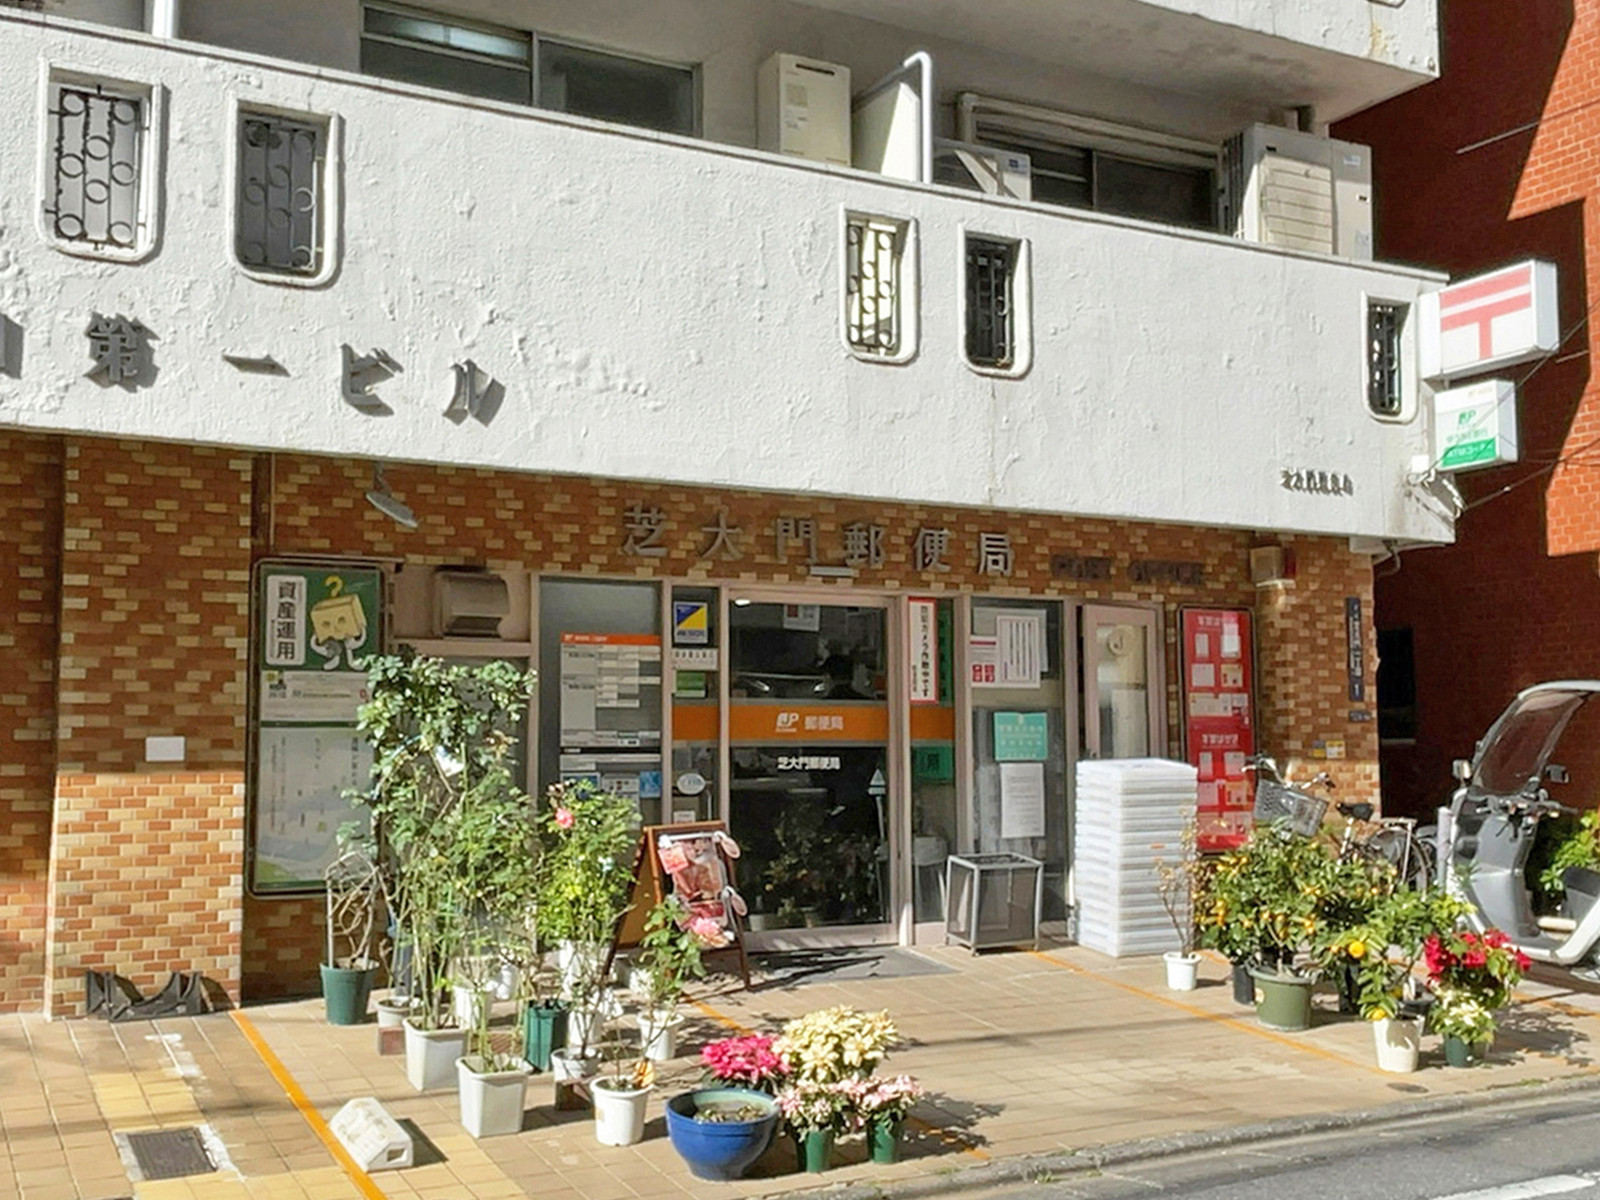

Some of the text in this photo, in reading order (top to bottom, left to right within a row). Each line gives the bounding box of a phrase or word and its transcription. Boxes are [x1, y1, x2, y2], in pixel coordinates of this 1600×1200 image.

[622, 505, 1014, 577] 芝大門郵便局
[276, 580, 297, 661] 資産運用
[776, 755, 841, 771] 芝大門郵便局
